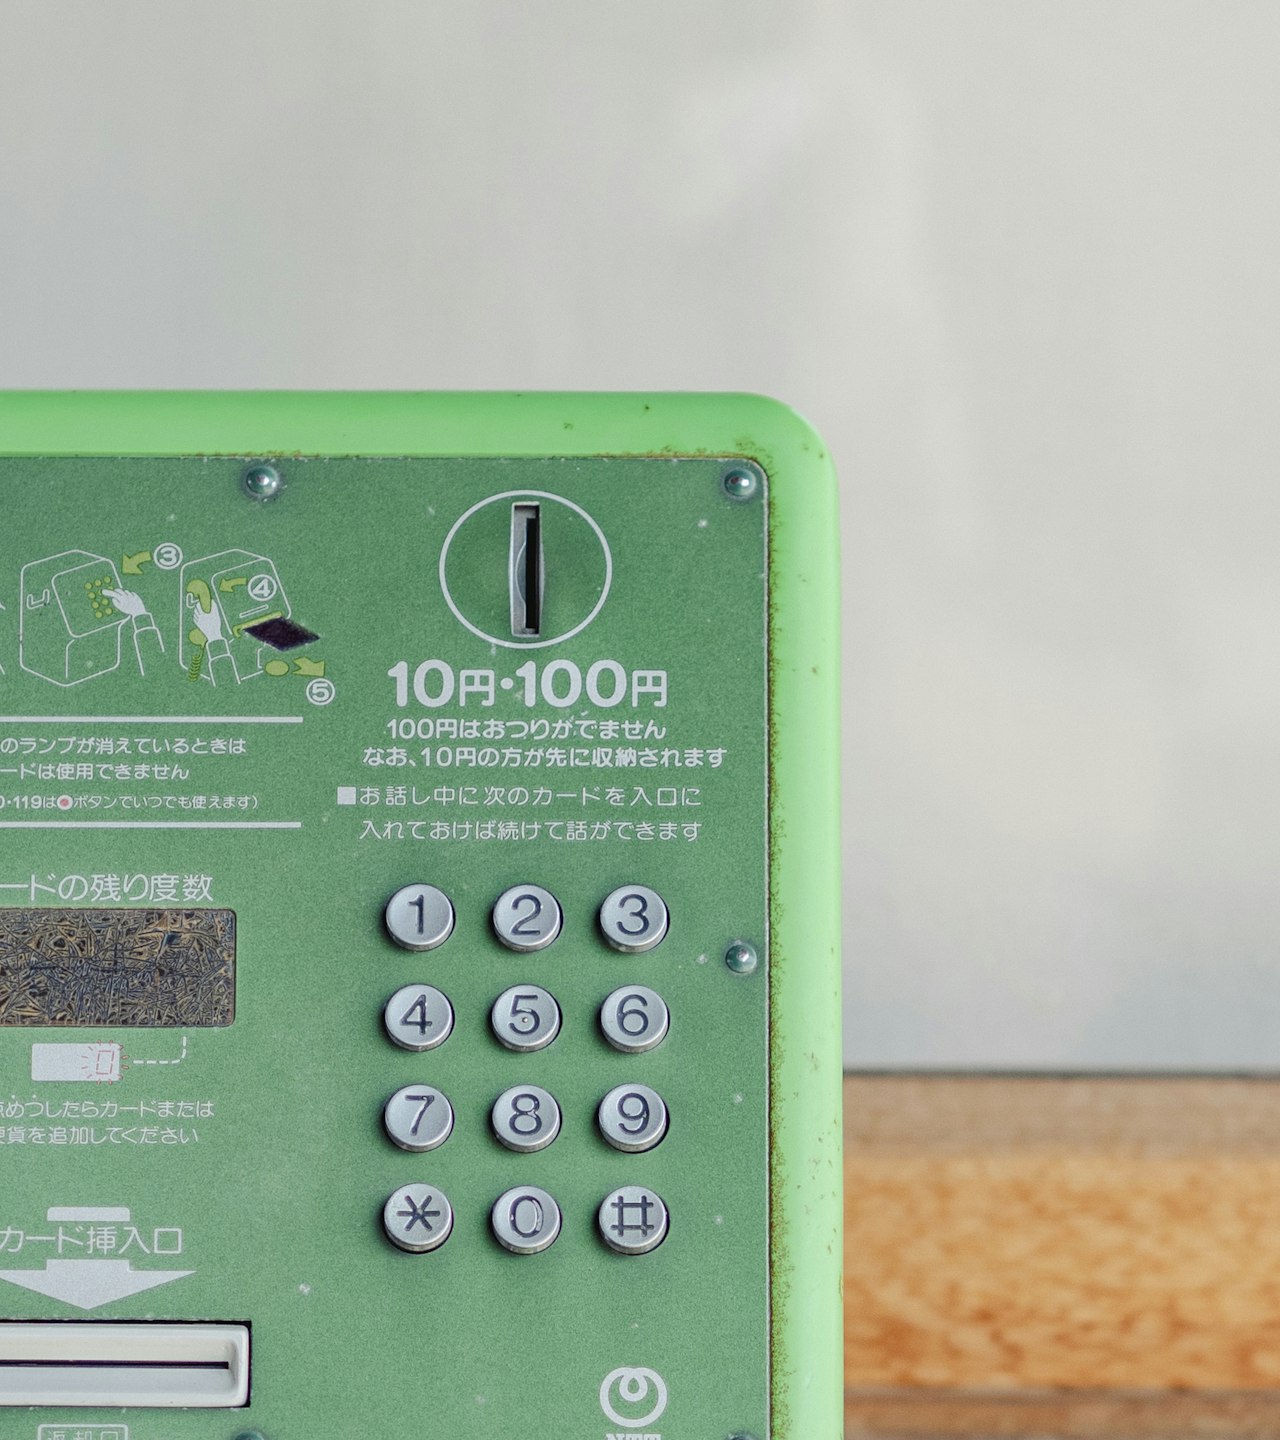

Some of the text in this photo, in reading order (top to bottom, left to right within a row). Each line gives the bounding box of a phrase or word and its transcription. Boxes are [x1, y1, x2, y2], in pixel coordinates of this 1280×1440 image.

[387, 718, 666, 740] 100円はおつりがでません
[362, 747, 727, 769] なお、10円の方が先に収納されます
[359, 821, 702, 841] 入れておけば続けて話ができます
[408, 894, 650, 935] 1 2 3
[401, 994, 649, 1036] 4 5 6
[405, 1093, 650, 1135] 7 8 9
[509, 1195, 544, 1238] 0
